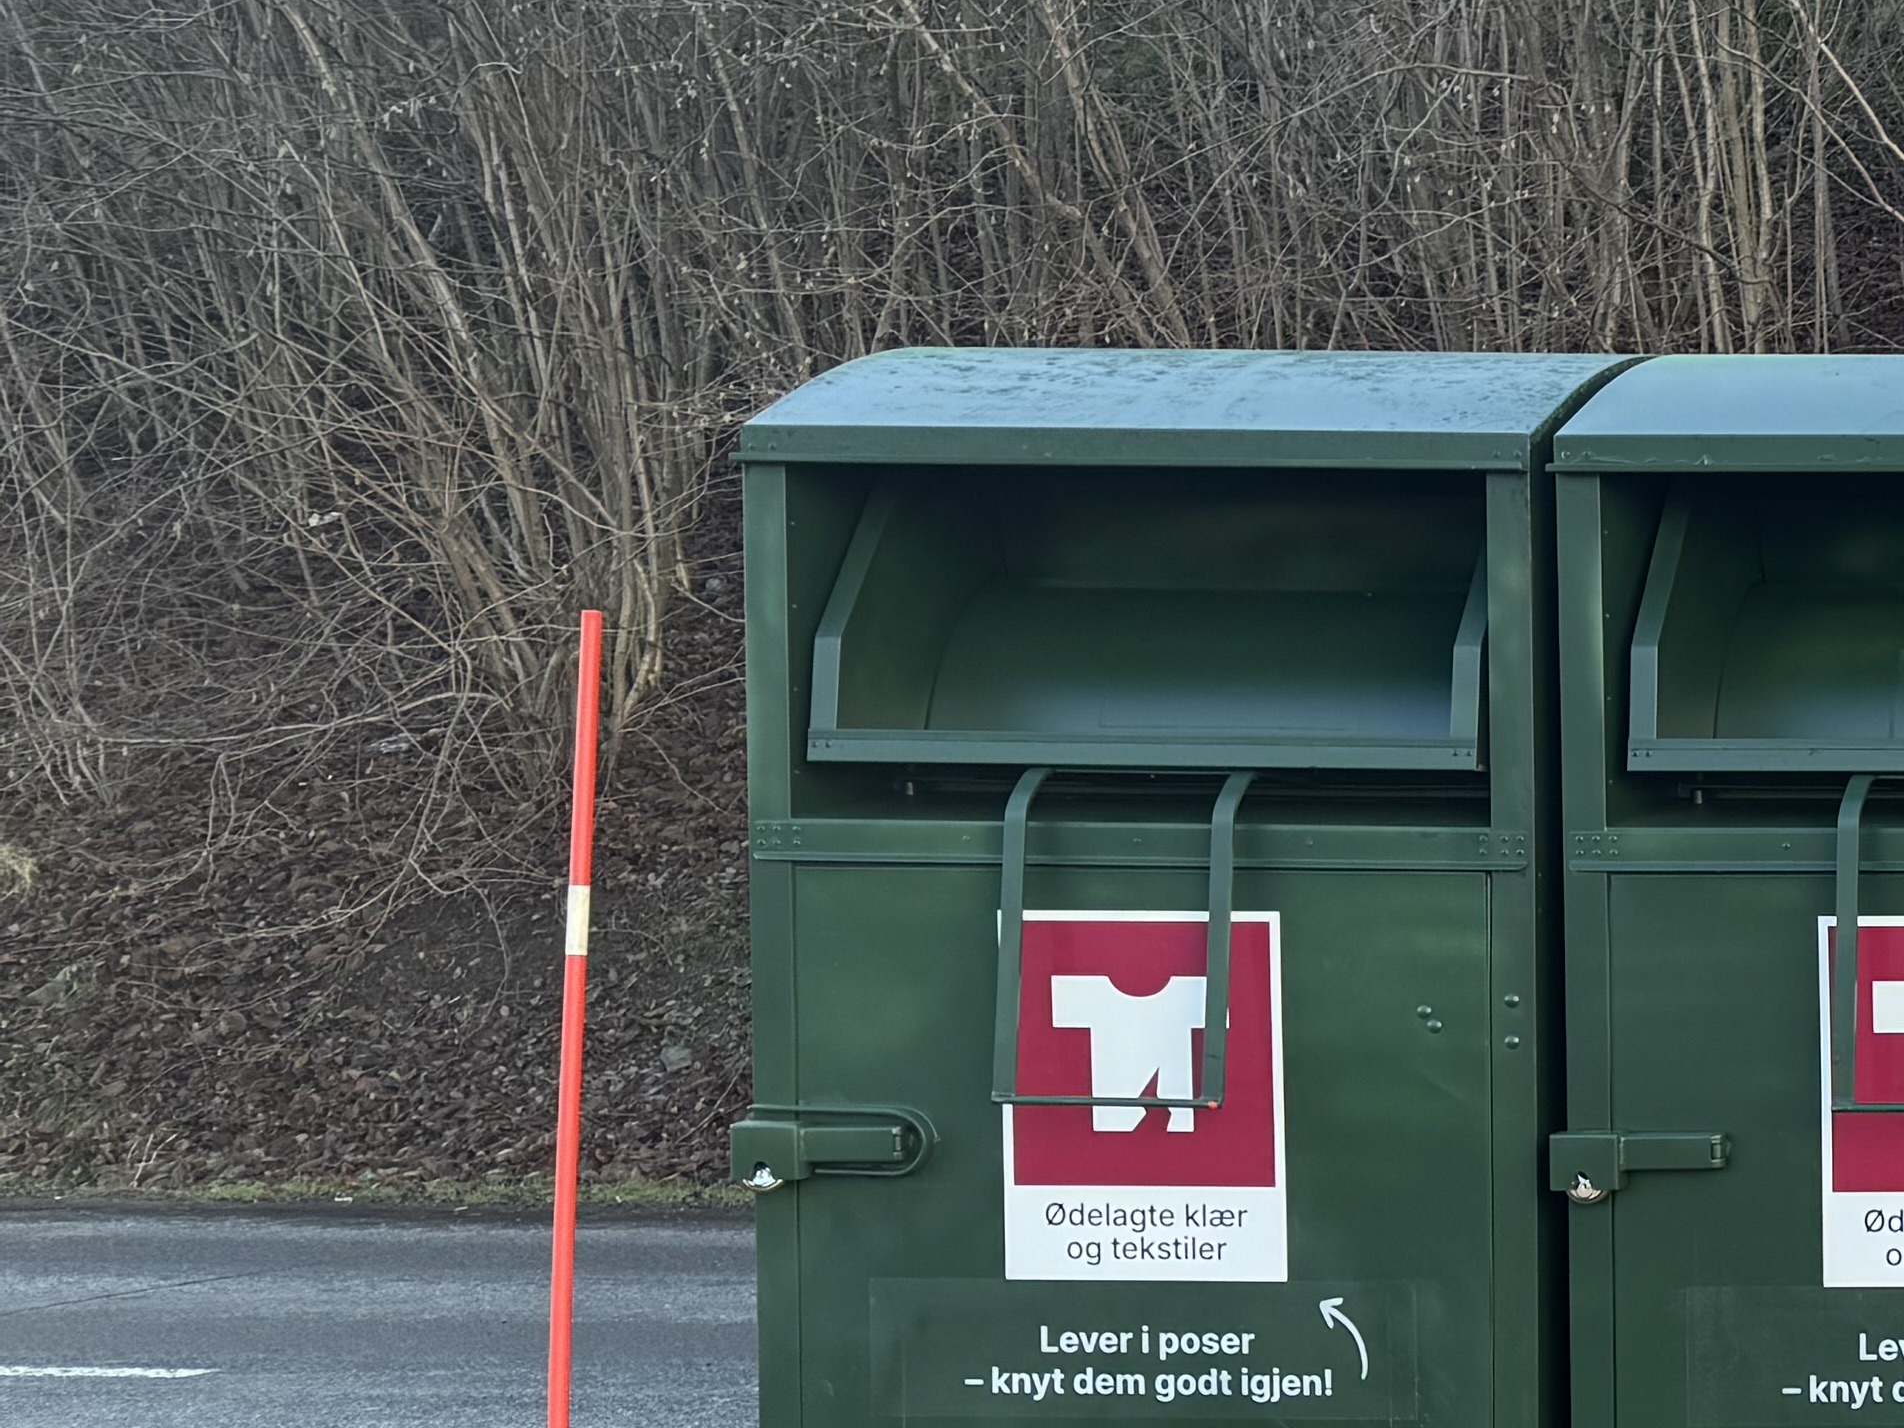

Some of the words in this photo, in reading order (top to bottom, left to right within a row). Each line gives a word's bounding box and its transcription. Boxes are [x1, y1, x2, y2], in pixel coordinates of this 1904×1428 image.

[1045, 1202, 1175, 1233] Ødelagte
[1185, 1203, 1248, 1228] klær
[1067, 1241, 1101, 1266] og
[1111, 1236, 1227, 1261] tekstiler
[1040, 1325, 1134, 1354] Lever
[1141, 1324, 1150, 1354] i
[1159, 1332, 1256, 1361] poser
[991, 1366, 1065, 1401] knyt
[1073, 1366, 1146, 1395] dem
[1154, 1367, 1233, 1403] godt
[1241, 1366, 1333, 1403] igjen!
[1809, 1374, 1884, 1410] knyt
